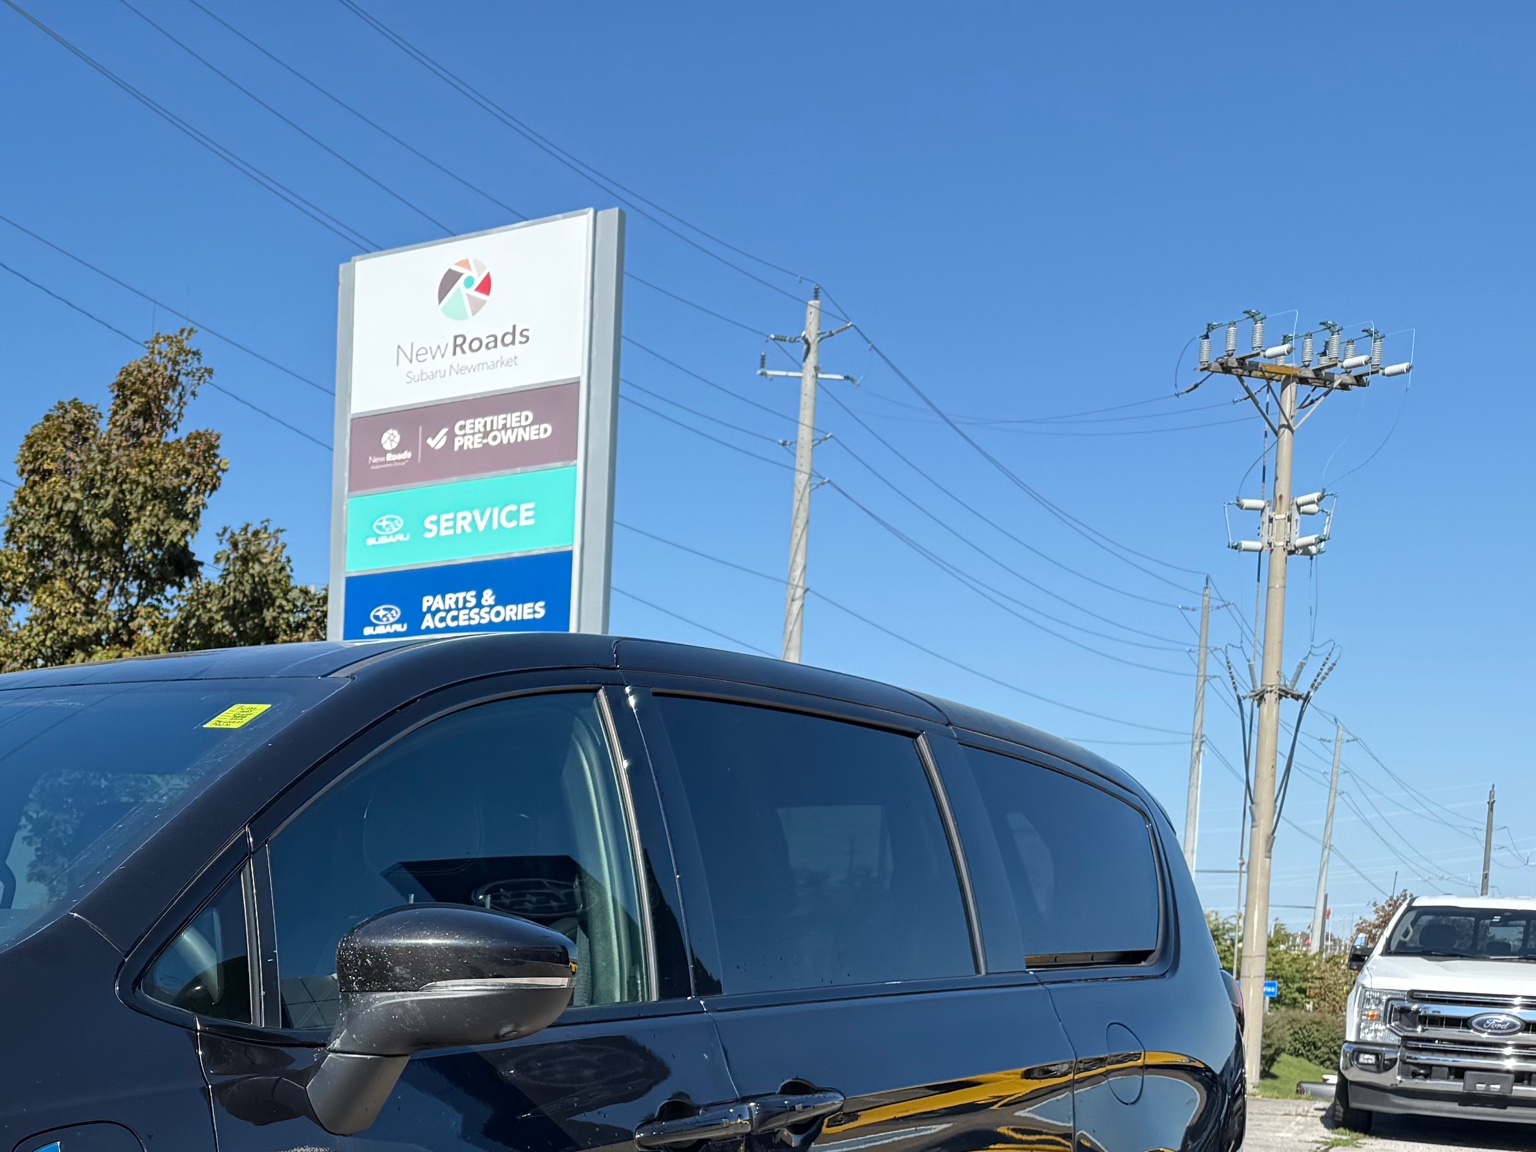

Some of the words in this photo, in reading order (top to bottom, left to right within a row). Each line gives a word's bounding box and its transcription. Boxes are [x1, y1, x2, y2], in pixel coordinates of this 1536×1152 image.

[405, 365, 447, 385] Subaru
[448, 355, 518, 379] Newmarket
[454, 410, 534, 437] CERTIFIED
[454, 423, 553, 452] PRE-OWNED
[423, 502, 536, 539] SERVICE
[366, 533, 410, 546] SUBARU
[421, 590, 476, 612] PARTS
[480, 589, 496, 606] &
[363, 622, 407, 635] SUBARU
[421, 602, 546, 630] ACCESSORIES
[1483, 1018, 1510, 1030] Ford
